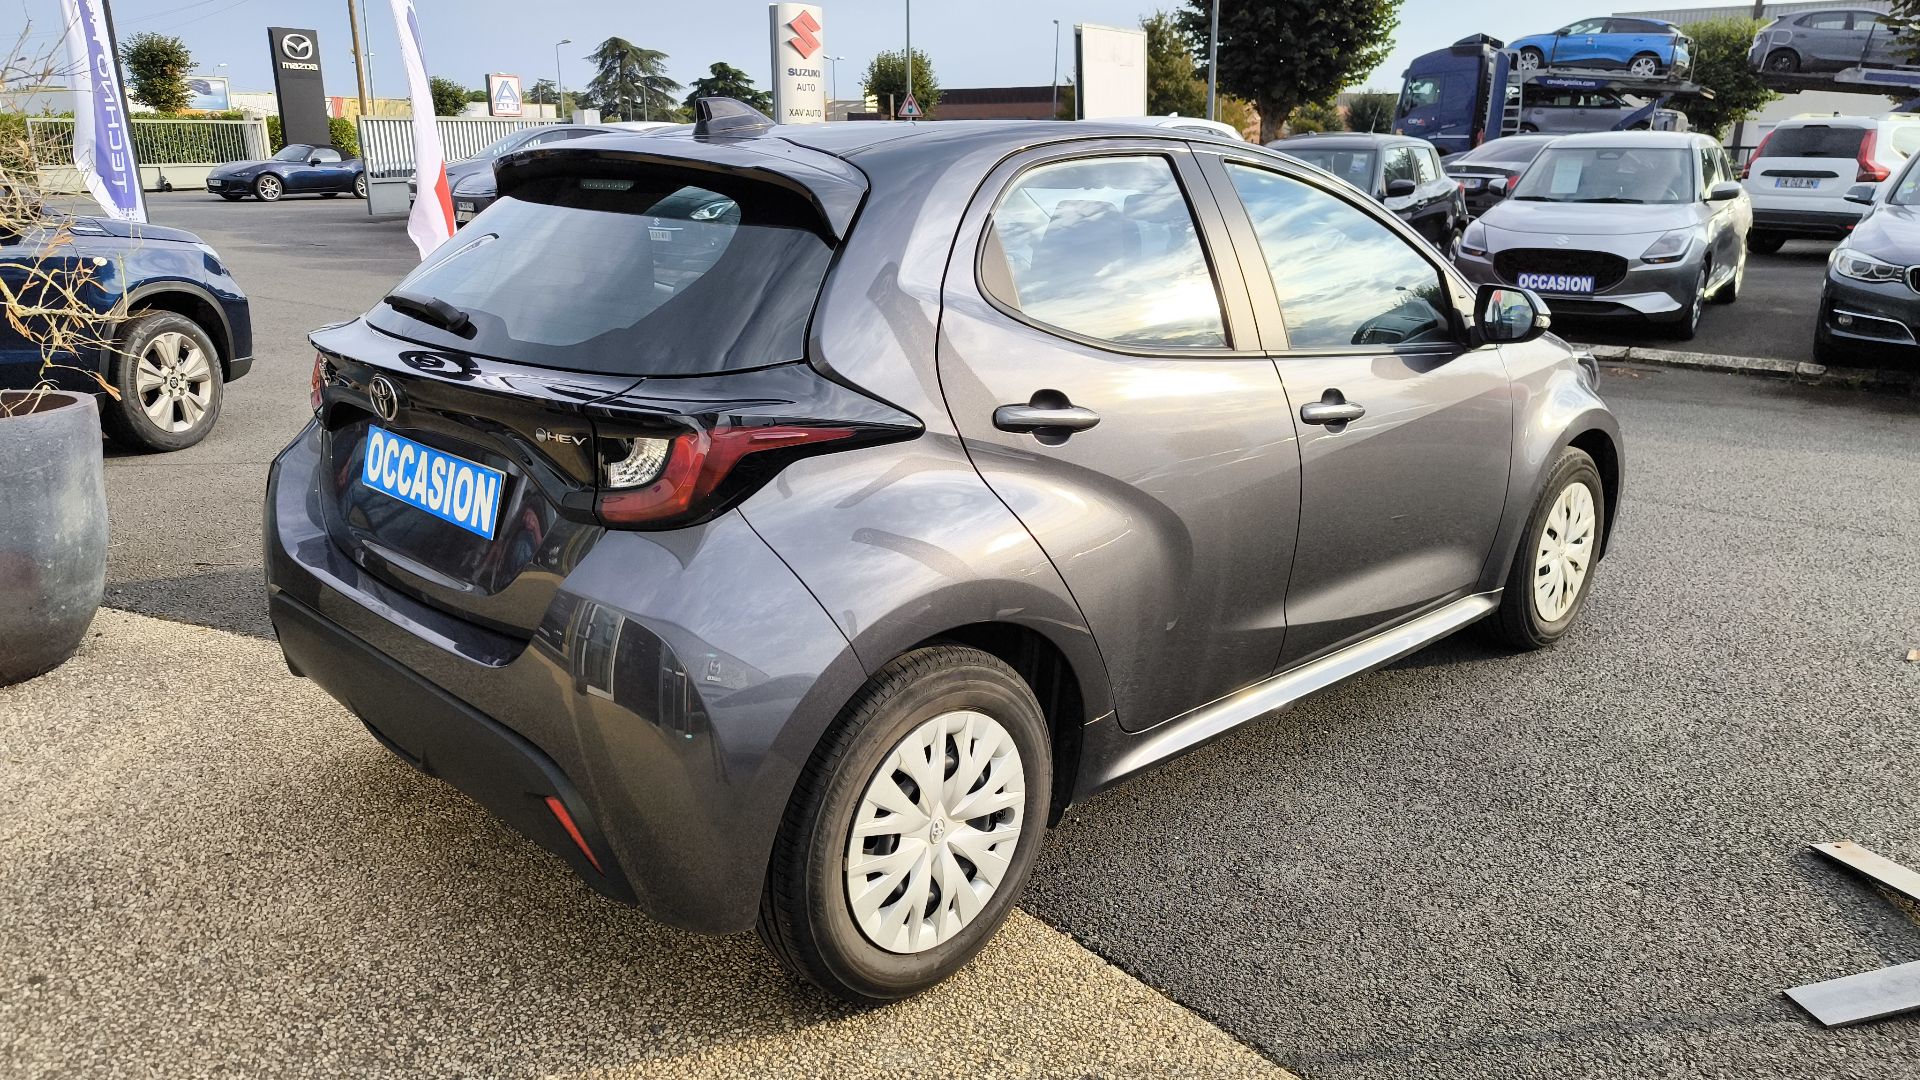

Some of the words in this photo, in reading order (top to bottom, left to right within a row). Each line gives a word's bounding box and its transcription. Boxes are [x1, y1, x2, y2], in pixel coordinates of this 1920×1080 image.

[788, 68, 820, 77] SUZUKI
[796, 84, 816, 92] AUTO
[789, 109, 821, 117] XAV'AUTO
[1518, 273, 1592, 292] OCCASION
[546, 431, 588, 446] HEV
[367, 432, 496, 532] OCCASION
